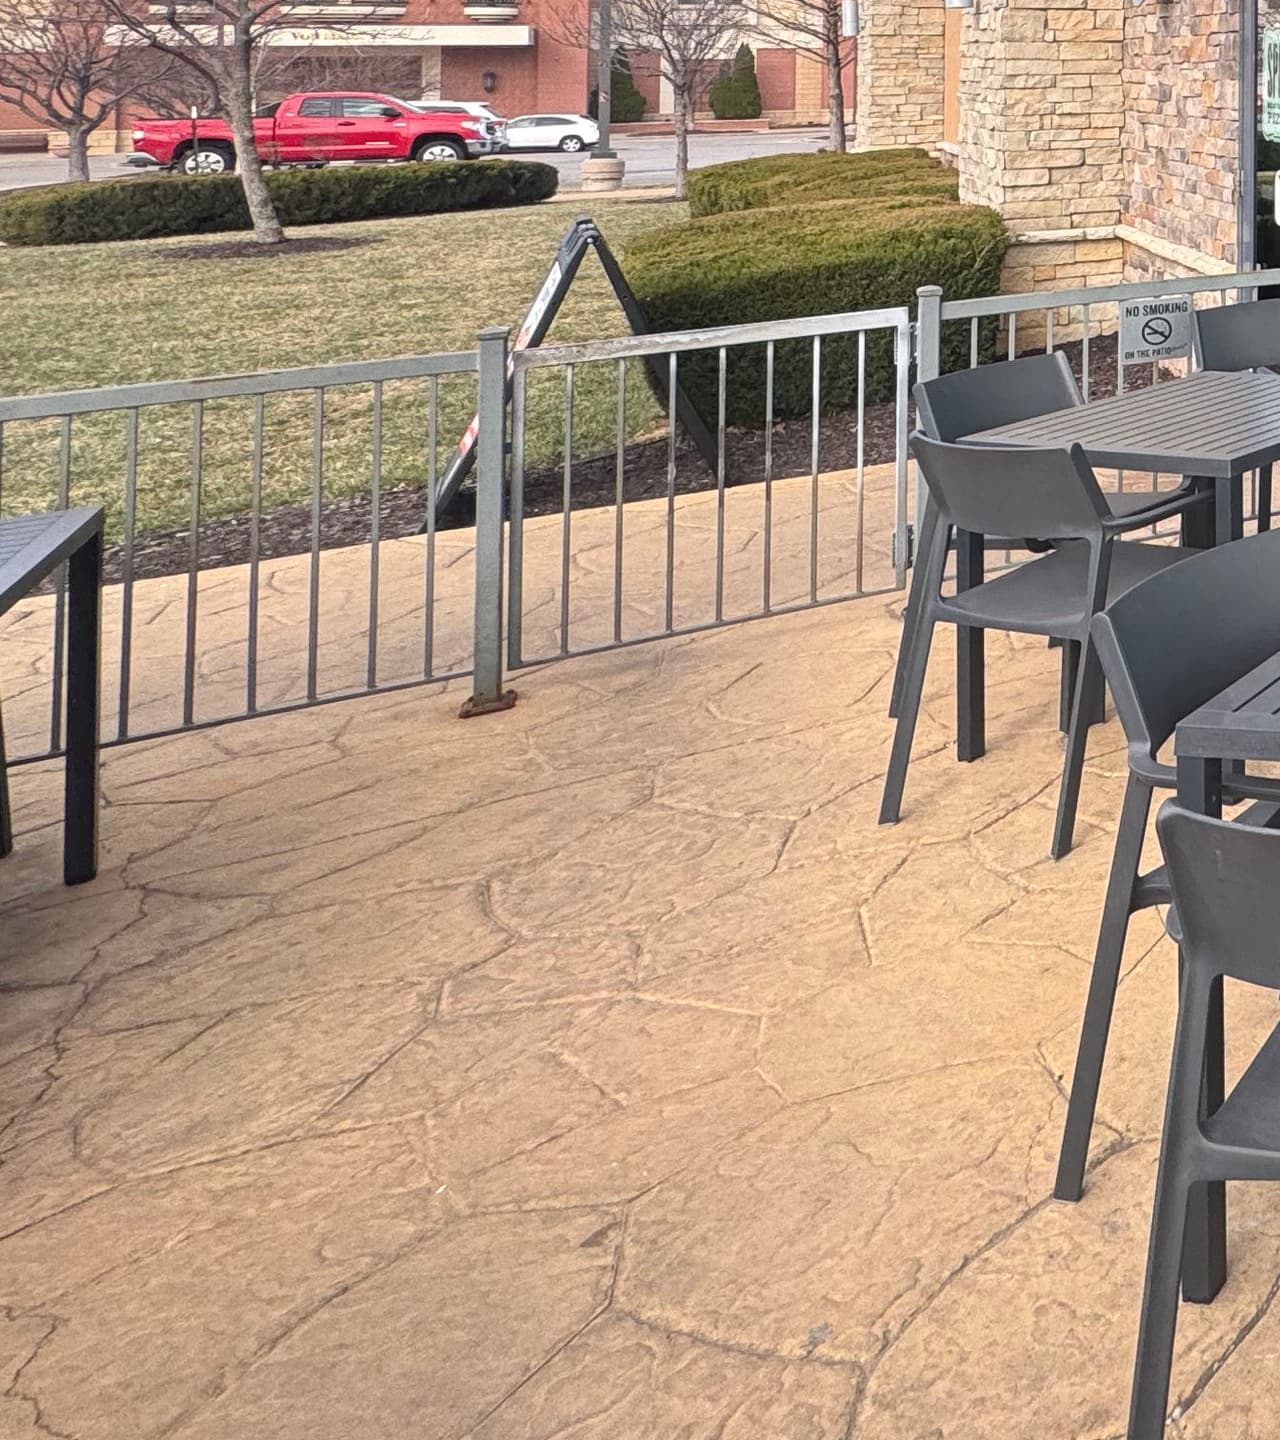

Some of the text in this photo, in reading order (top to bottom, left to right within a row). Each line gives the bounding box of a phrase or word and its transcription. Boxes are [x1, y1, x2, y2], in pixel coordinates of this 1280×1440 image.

[1125, 301, 1188, 318] NO SMOKING
[1124, 351, 1134, 360] ON
[1137, 349, 1149, 358] THE
[1152, 346, 1171, 356] PATIO
